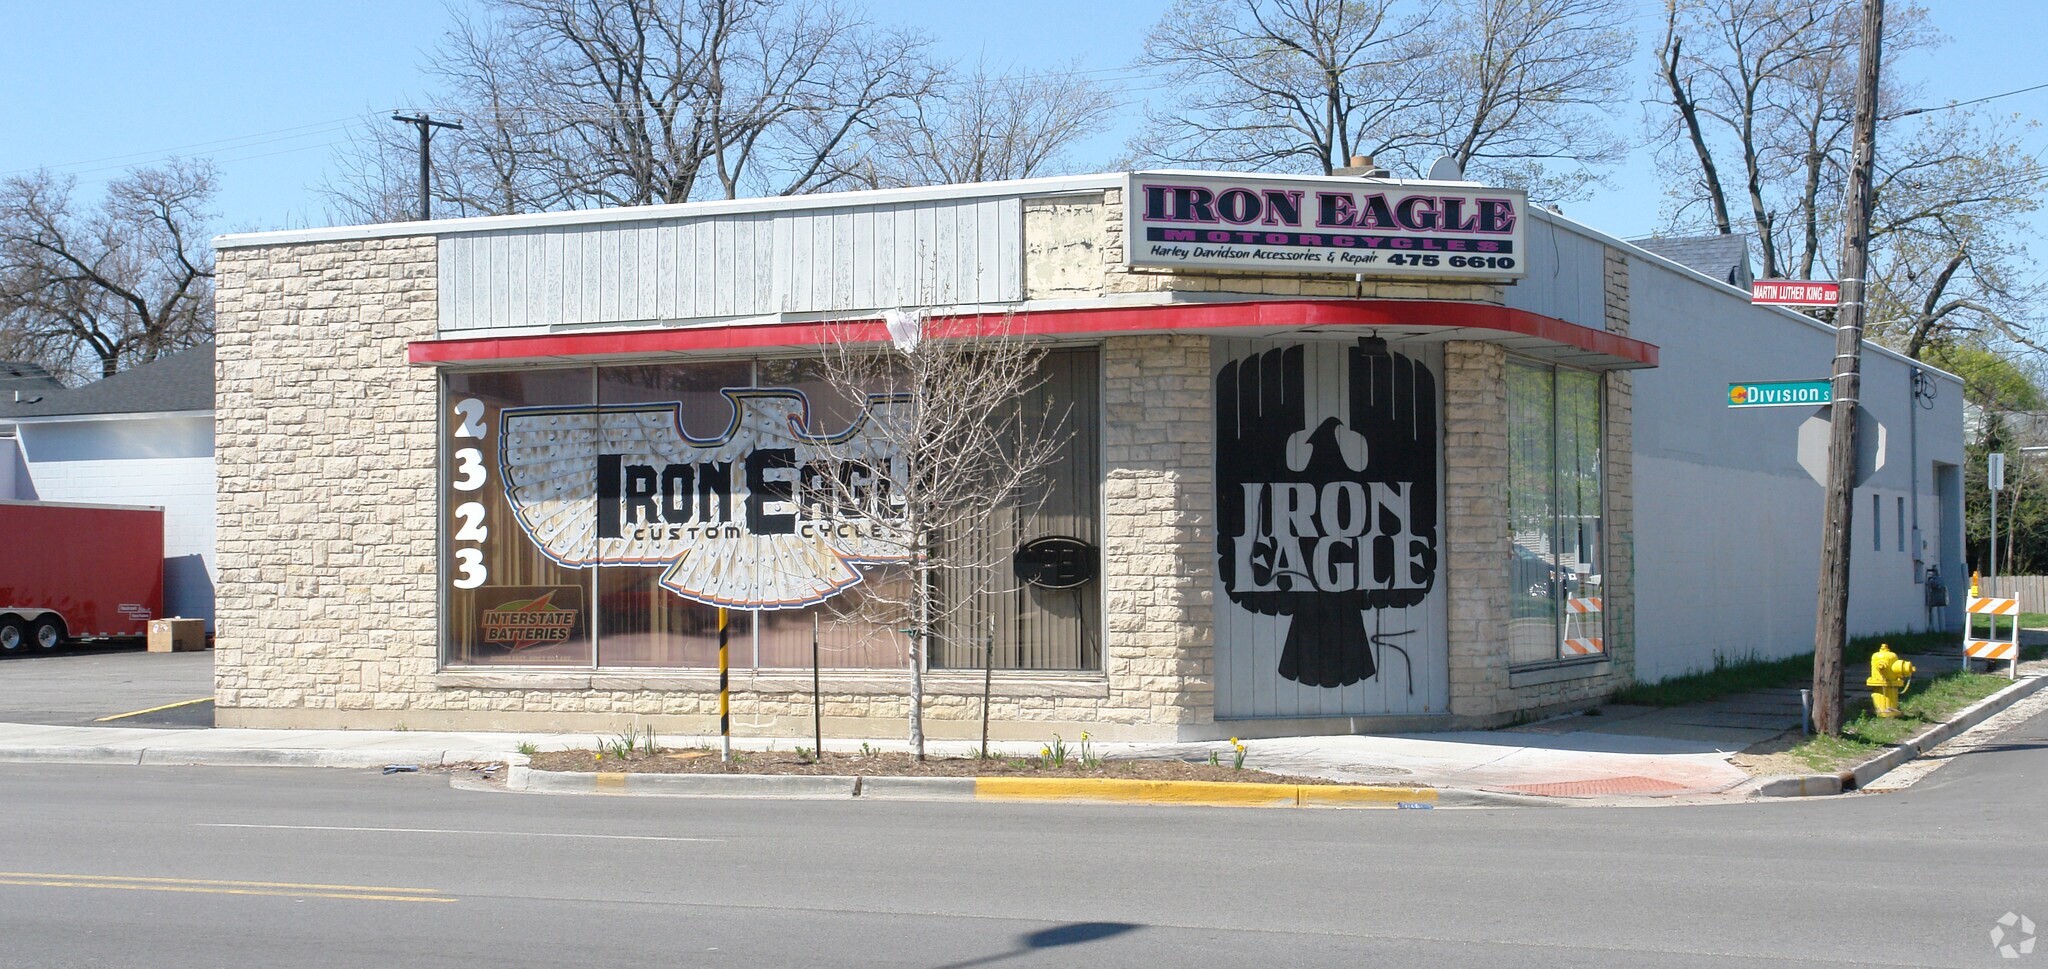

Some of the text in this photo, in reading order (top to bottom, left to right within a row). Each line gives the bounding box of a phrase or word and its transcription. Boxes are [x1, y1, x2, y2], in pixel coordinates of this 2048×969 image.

[1143, 185, 1516, 234] IRON EAGLE
[1164, 230, 1499, 252] MOTORCYCLES
[1151, 245, 1515, 269] Harley Davidson Accessories & Repair 475 6610
[1753, 285, 1837, 301] MARTIN LUTHER KING BLVD
[1747, 387, 1829, 403] Division S
[453, 398, 488, 590] 2323
[597, 448, 925, 538] IRON EAGL
[1240, 481, 1413, 538] IRON
[633, 526, 741, 541] CUSTOM
[1231, 536, 1430, 592] EAGLE
[485, 612, 573, 625] INTERSTATE
[488, 627, 568, 640] BATTERIES
